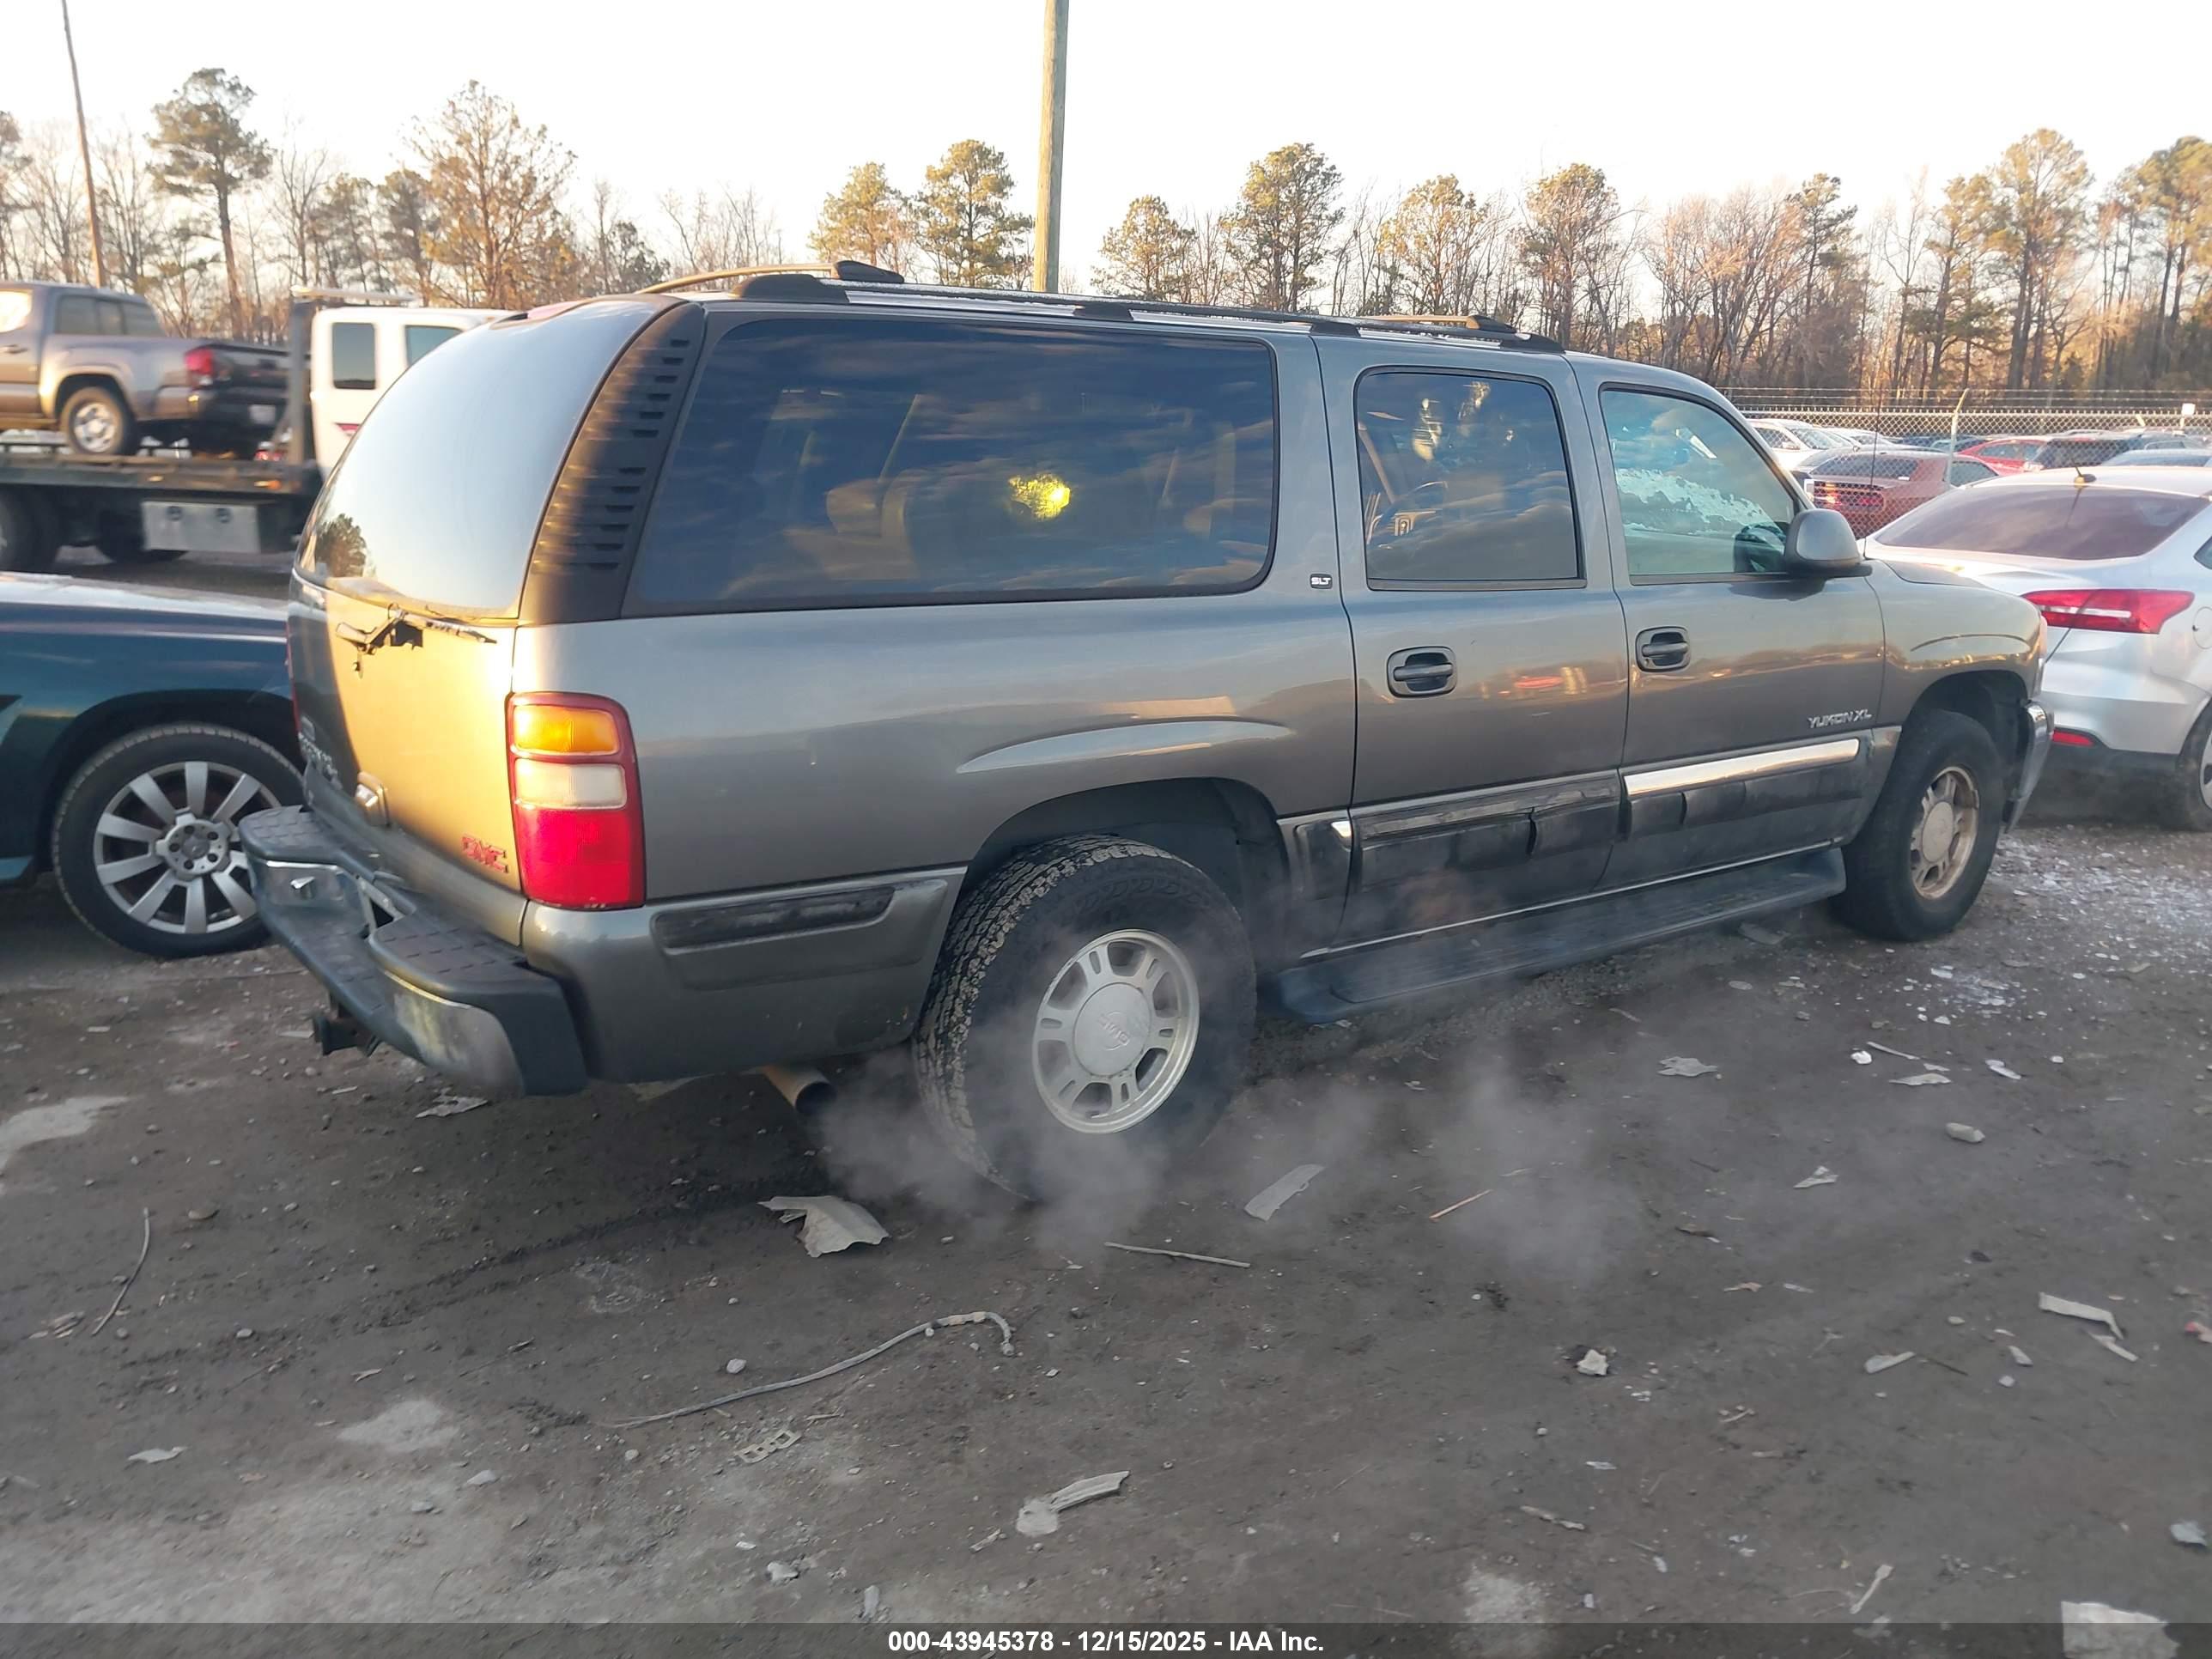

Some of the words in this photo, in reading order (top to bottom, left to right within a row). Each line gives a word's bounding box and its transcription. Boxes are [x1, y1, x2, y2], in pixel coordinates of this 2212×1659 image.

[1311, 577, 1332, 586] SLT
[1808, 711, 1854, 728] YUKON
[1853, 708, 1872, 721] XL
[462, 834, 509, 873] GMC
